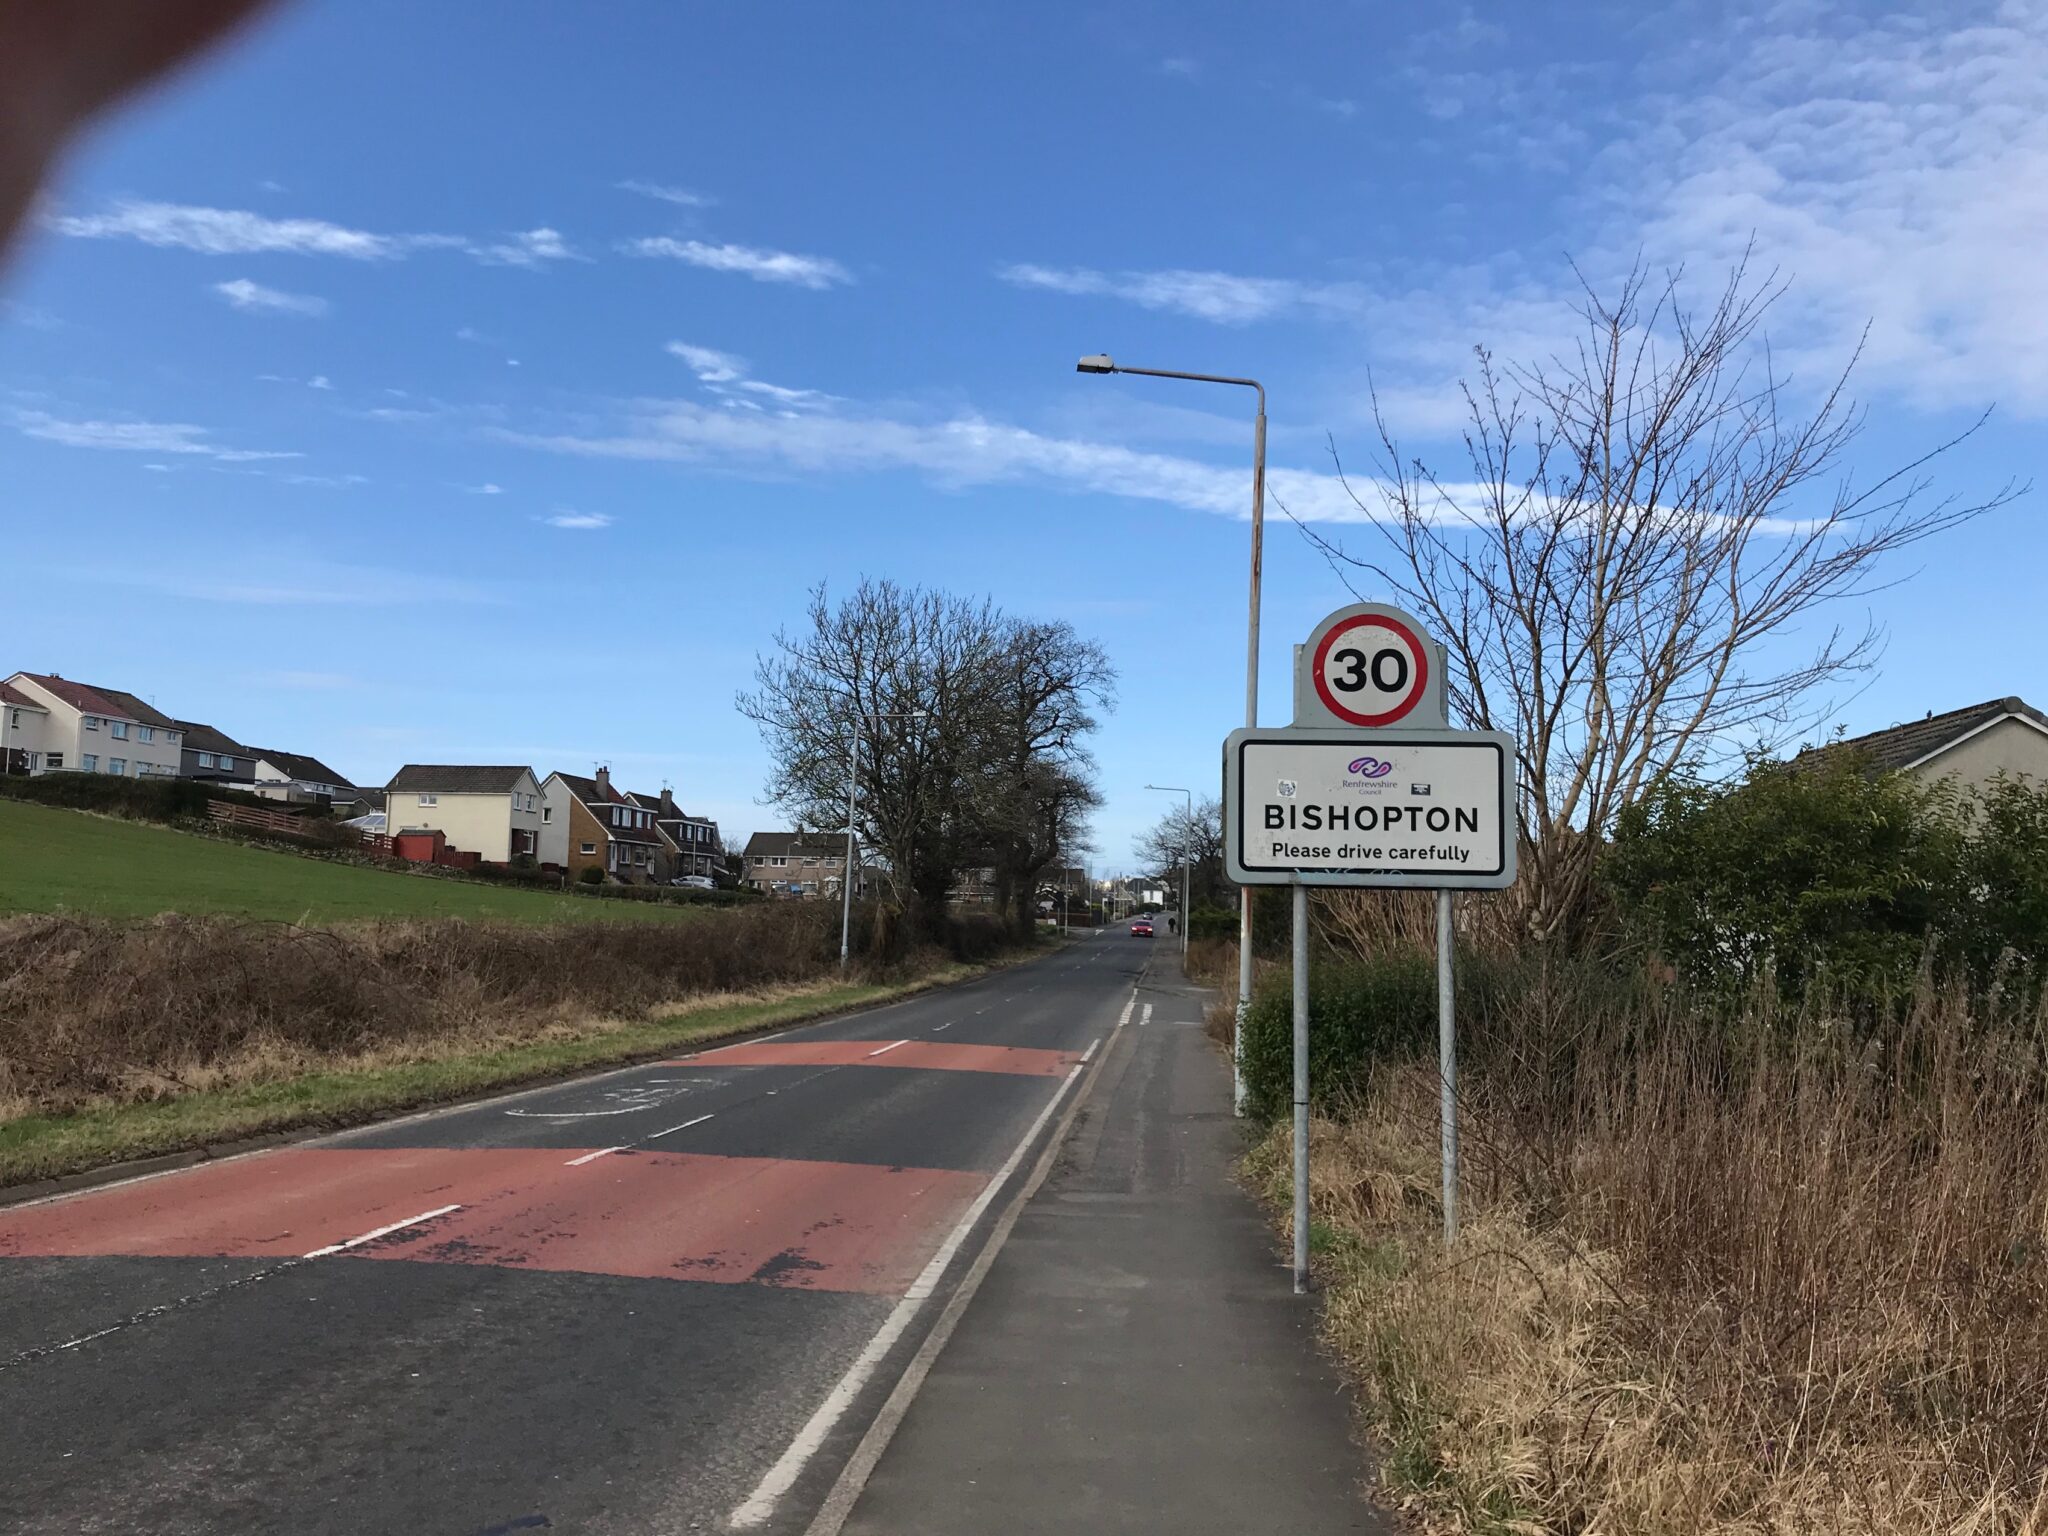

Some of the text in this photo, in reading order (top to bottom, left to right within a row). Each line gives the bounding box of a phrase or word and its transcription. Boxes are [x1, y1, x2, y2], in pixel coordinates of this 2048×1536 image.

[1333, 648, 1408, 693] 30
[1342, 780, 1398, 789] Renfrewshire
[1264, 804, 1478, 833] BISHOPTON
[1272, 842, 1470, 863] Please drive carefully
